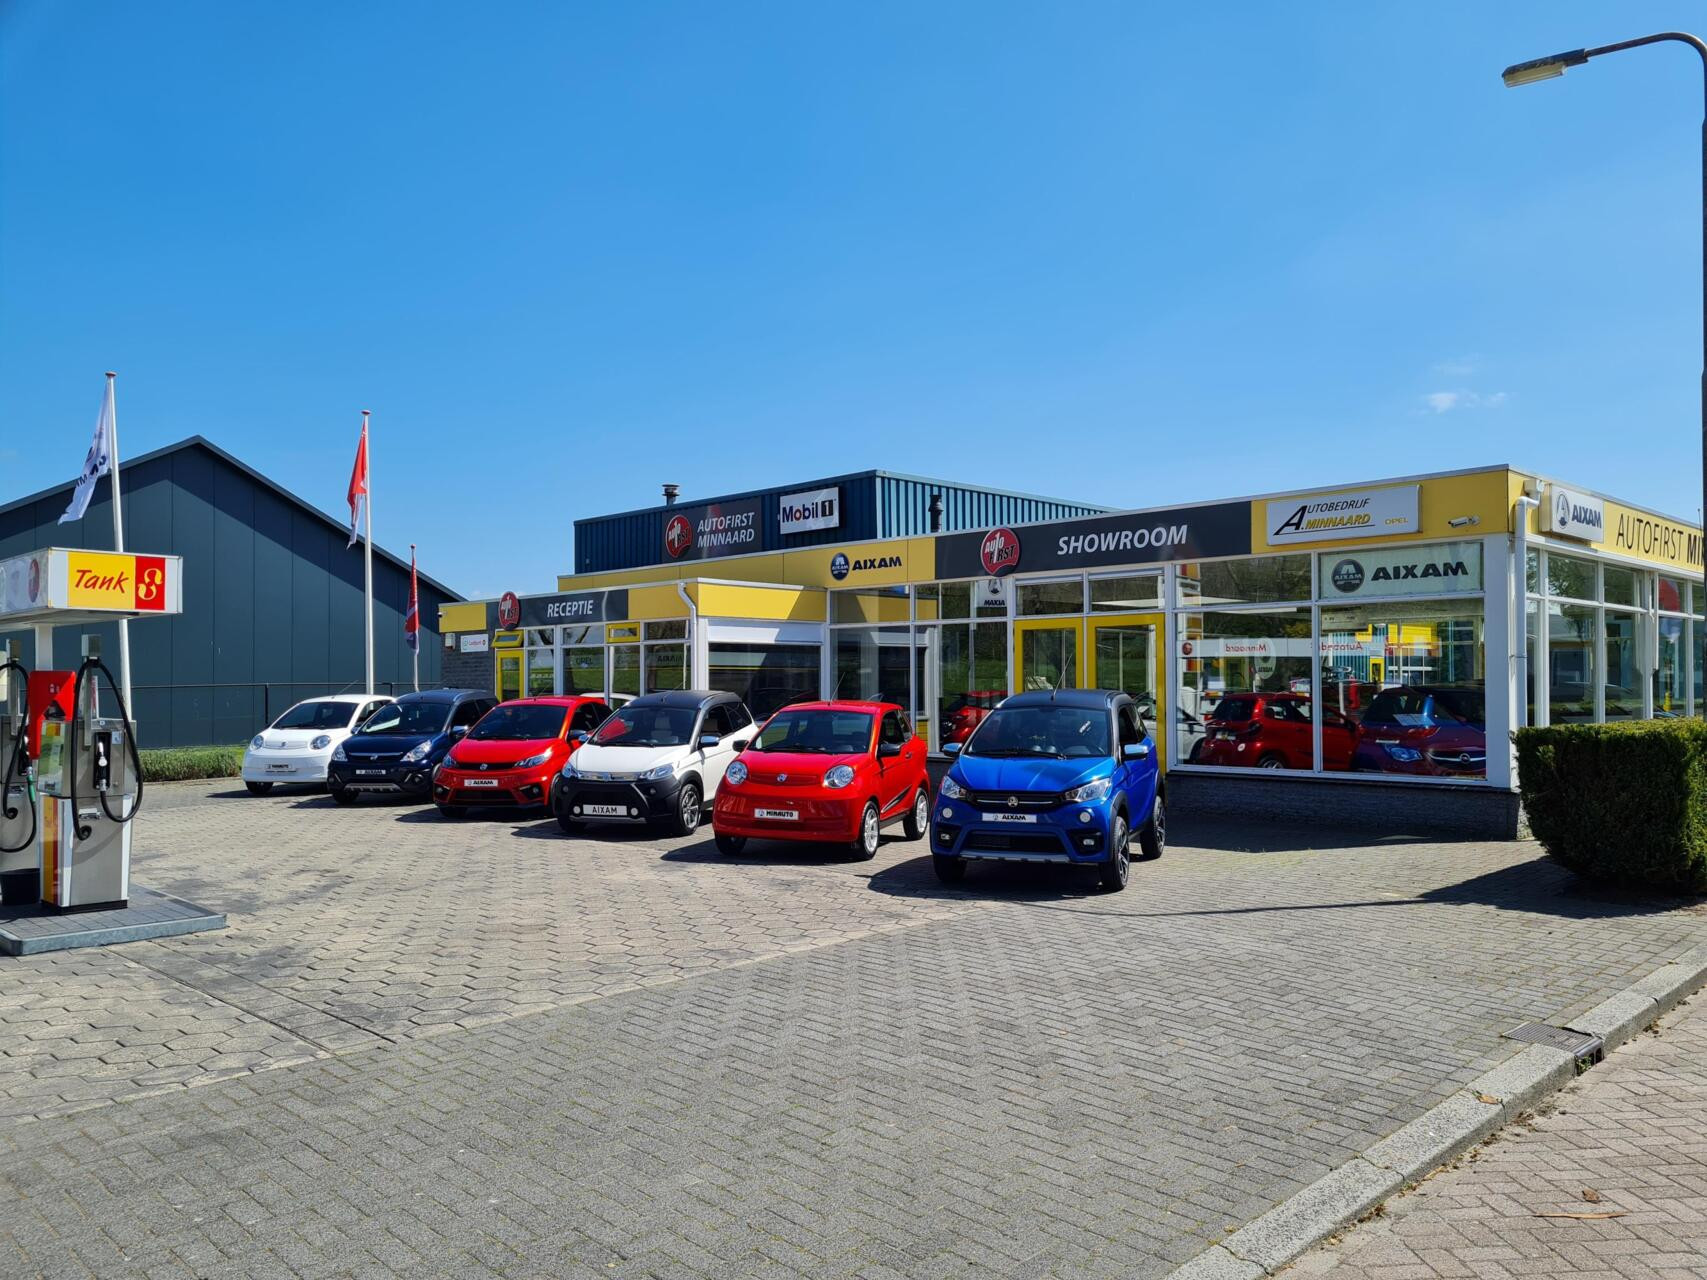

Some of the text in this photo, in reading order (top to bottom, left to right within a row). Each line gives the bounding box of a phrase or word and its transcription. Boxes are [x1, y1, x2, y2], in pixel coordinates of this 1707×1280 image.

[697, 512, 755, 532] AUTOFIRST
[781, 501, 833, 524] Mobil 1
[1571, 504, 1602, 529] AIXAM
[697, 529, 755, 548] MINNAARD
[1057, 525, 1188, 556] SHOWROOM
[1616, 513, 1685, 561] AUTOFIRST
[852, 556, 902, 570] AIXAM
[1371, 561, 1468, 581] AIXAM
[75, 569, 128, 594] Tank
[547, 600, 593, 618] RECEPTIE
